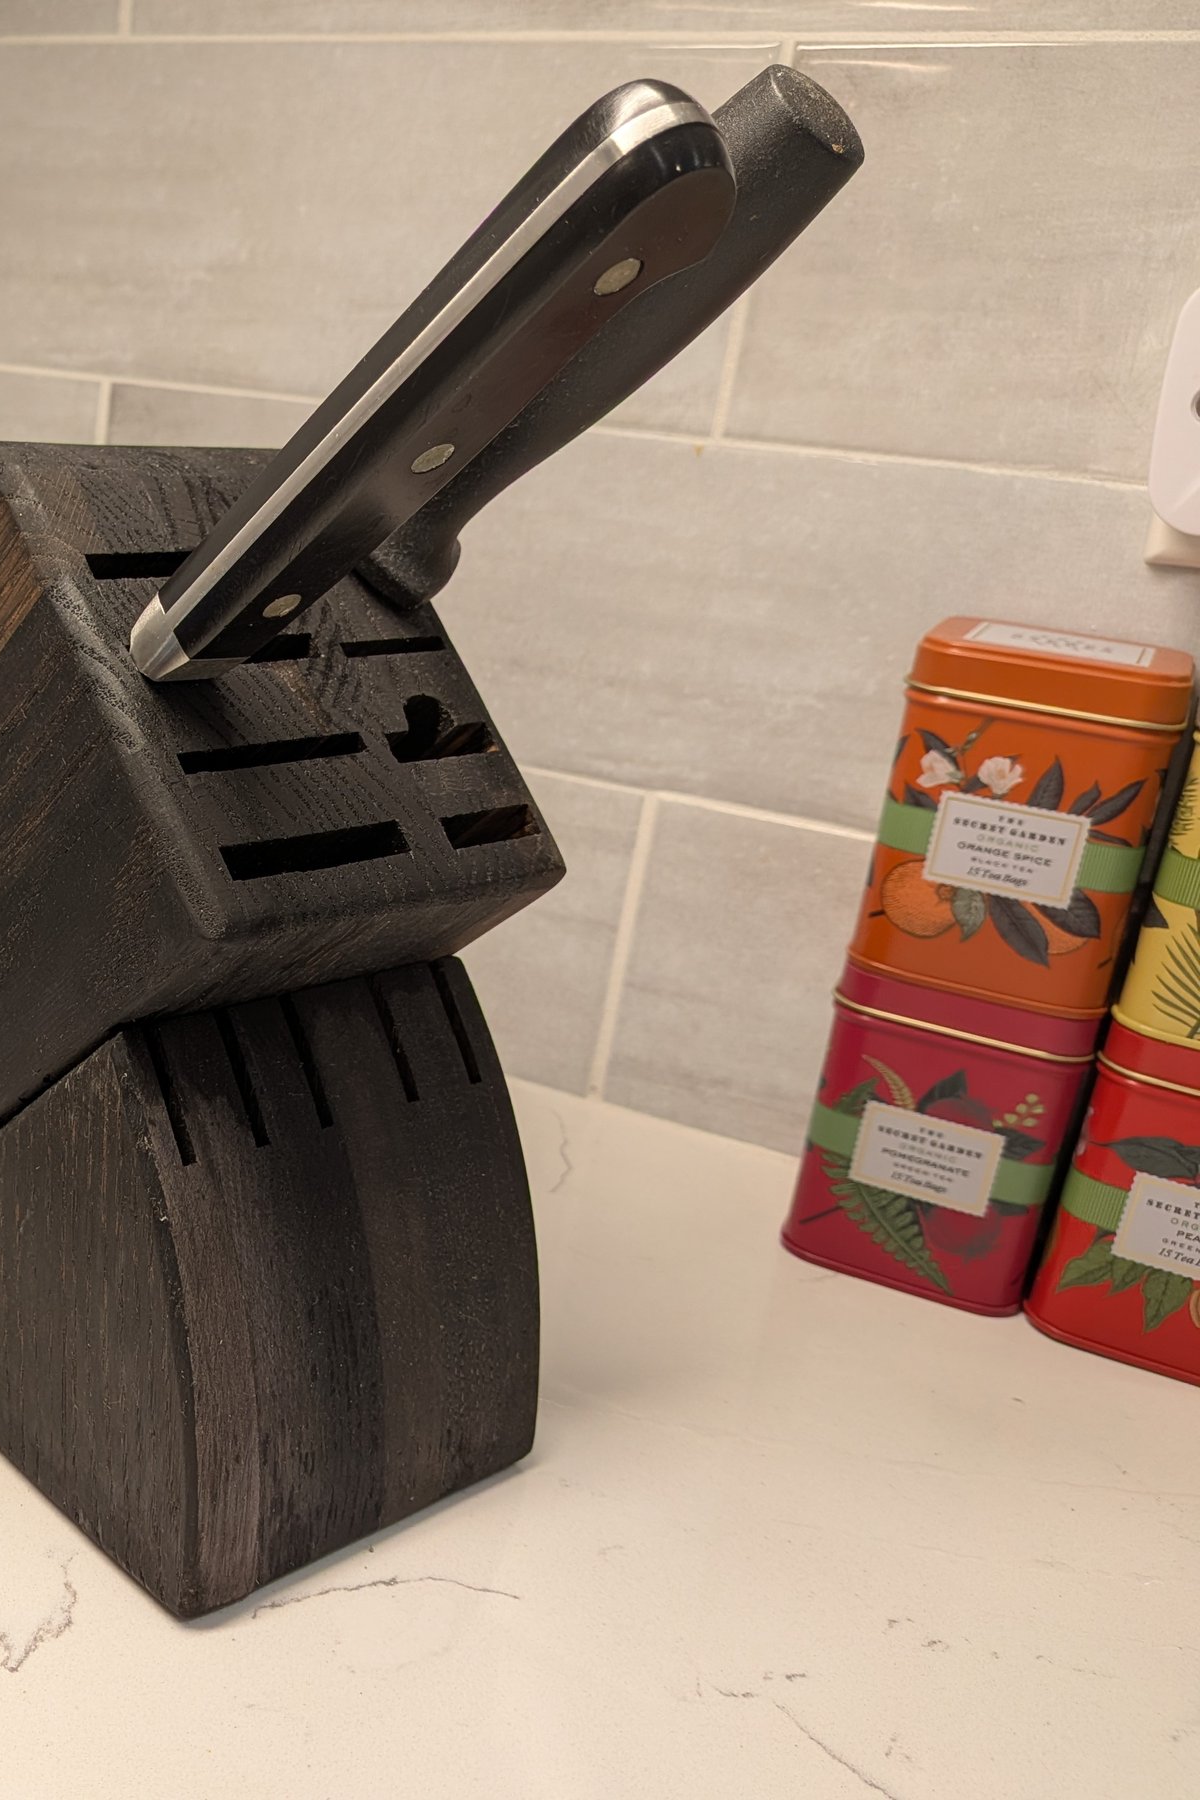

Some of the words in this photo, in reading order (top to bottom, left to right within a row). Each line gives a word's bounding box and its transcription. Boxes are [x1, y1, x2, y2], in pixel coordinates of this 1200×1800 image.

[953, 817, 1005, 834] SECRET
[1009, 828, 1067, 846] GARDEN
[977, 834, 1040, 853] ORGANIC
[957, 841, 1010, 859] ORANGE
[1013, 852, 1053, 867] SPICE
[967, 866, 981, 876] 15
[981, 868, 1001, 881] Tea
[1002, 873, 1028, 887] Bags
[877, 1125, 927, 1144] SECRET
[929, 1140, 983, 1159] GARDEN
[880, 1147, 971, 1177] POMEGRANATE
[1159, 1247, 1173, 1258] 15
[1174, 1251, 1195, 1265] Tea
